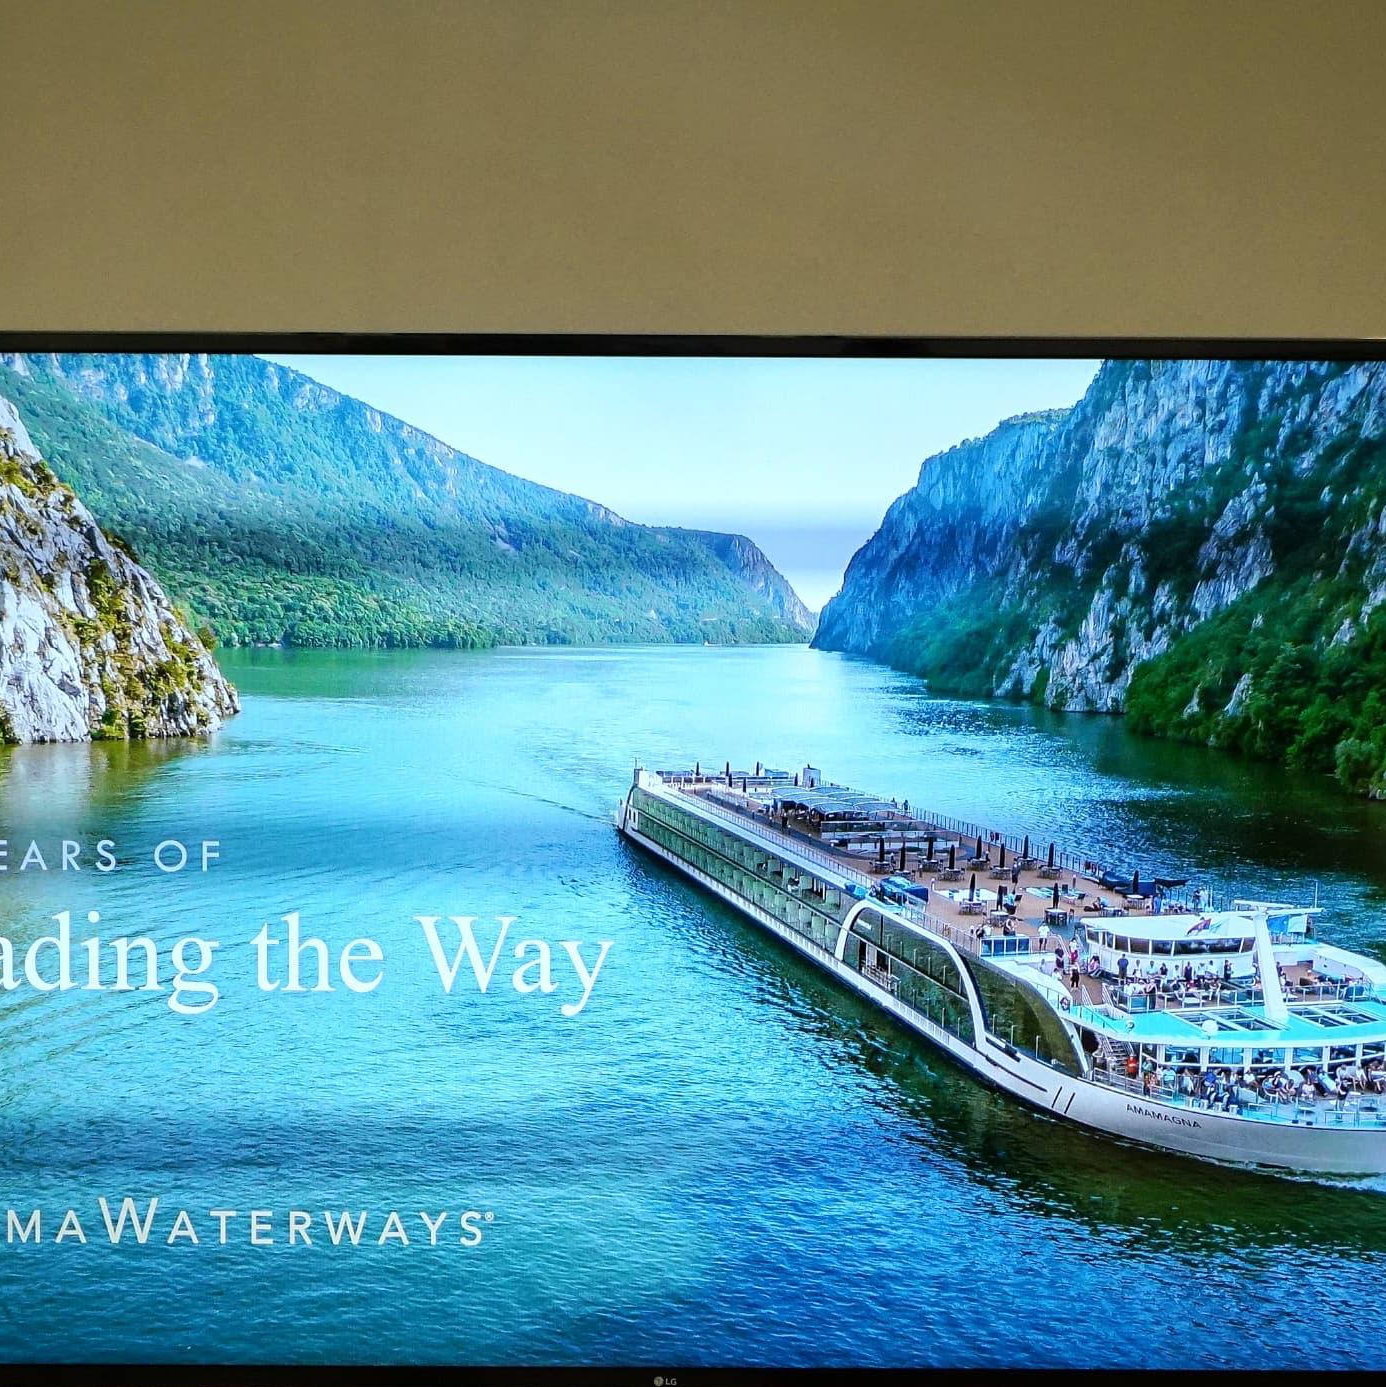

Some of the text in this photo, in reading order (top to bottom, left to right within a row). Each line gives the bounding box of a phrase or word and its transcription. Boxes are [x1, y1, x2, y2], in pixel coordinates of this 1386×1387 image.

[154, 839, 220, 873] OF
[249, 911, 385, 993] the
[414, 915, 614, 1017] Way
[1125, 1103, 1202, 1129] AMAMAGNA
